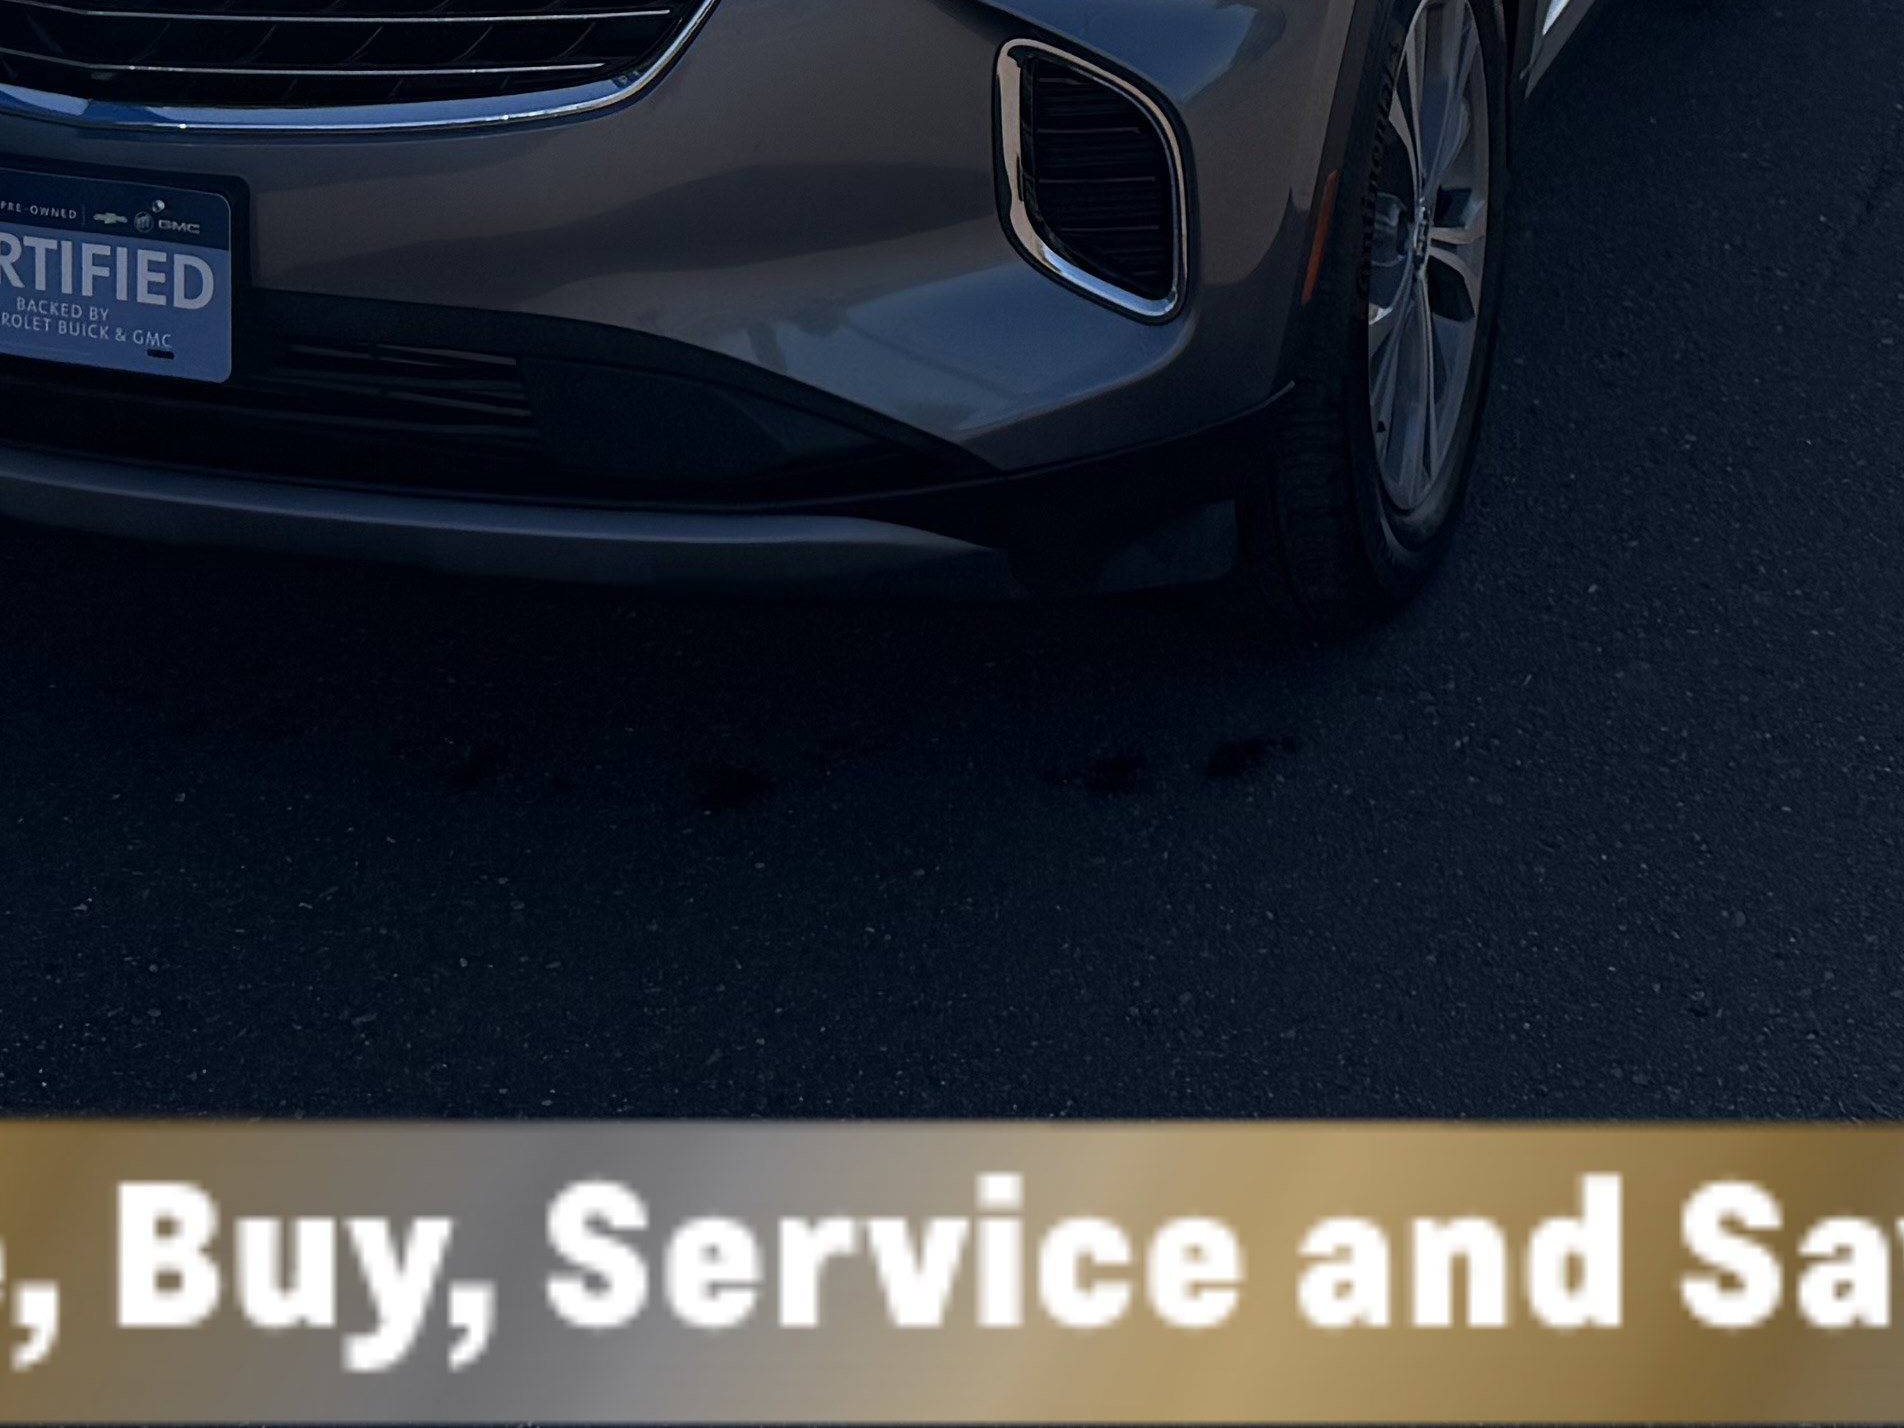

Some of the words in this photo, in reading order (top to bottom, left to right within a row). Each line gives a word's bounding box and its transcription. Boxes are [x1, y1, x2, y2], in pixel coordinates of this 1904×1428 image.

[158, 218, 201, 235] GMC
[16, 296, 83, 319] BACKED
[89, 306, 110, 322] BY
[58, 320, 110, 341] BUICK
[114, 327, 127, 343] &
[132, 329, 173, 349] GMC
